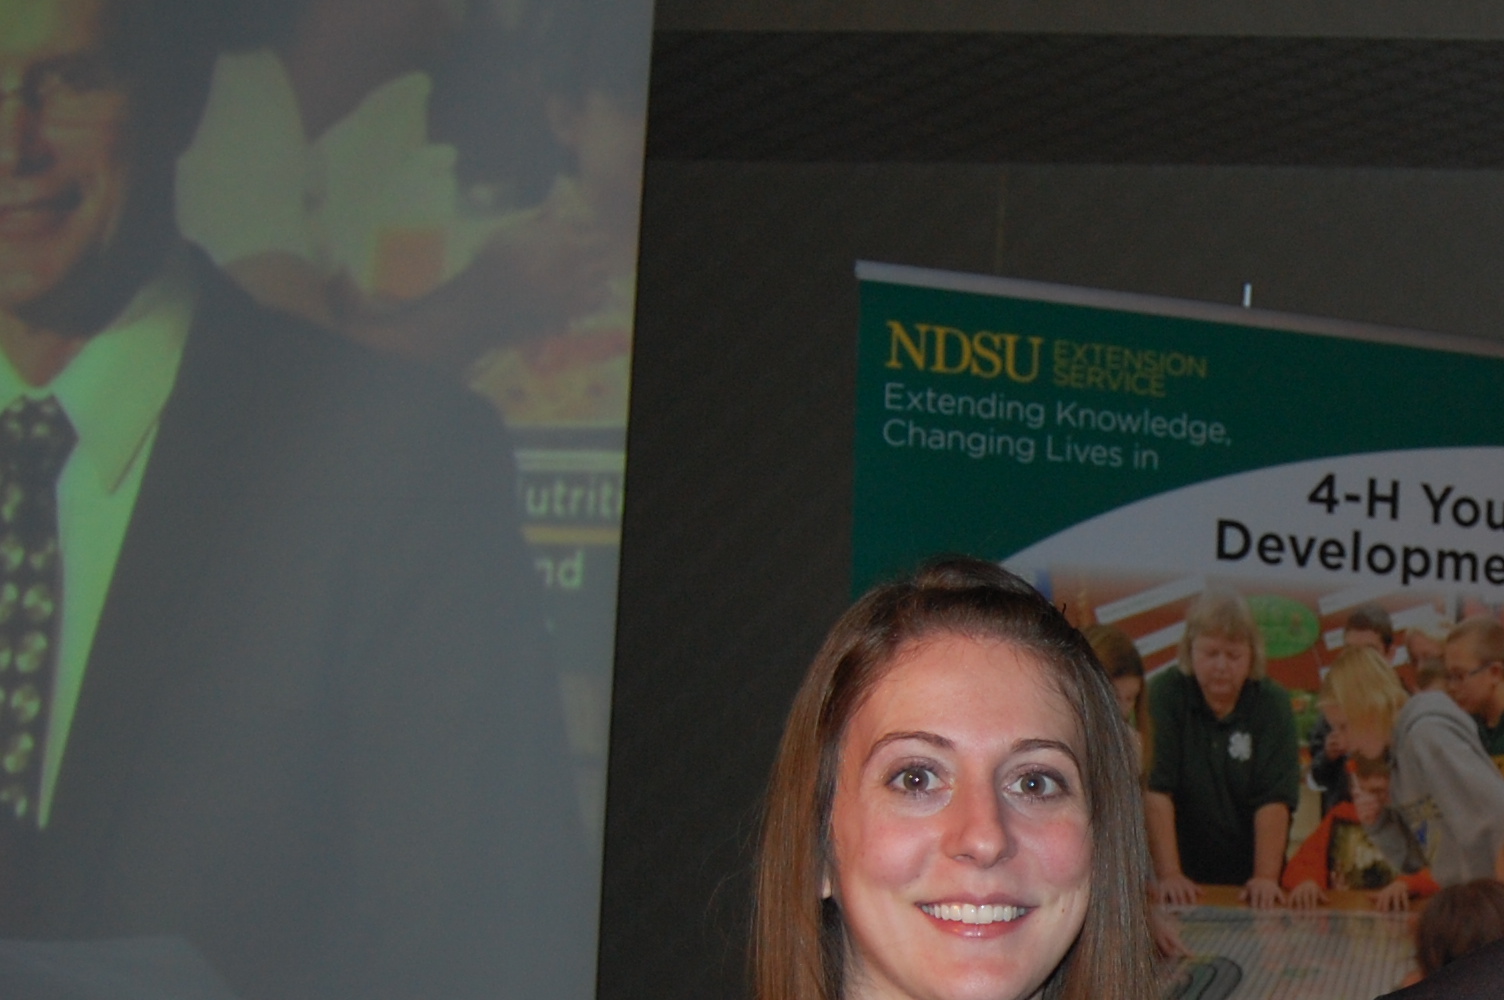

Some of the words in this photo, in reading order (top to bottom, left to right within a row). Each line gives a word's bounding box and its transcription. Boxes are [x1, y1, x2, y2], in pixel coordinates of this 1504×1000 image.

[885, 320, 1044, 383] NDSU
[1054, 340, 1209, 378] EXTENSION
[1053, 363, 1166, 397] SERVICE
[884, 382, 1045, 429] Extending
[1056, 401, 1232, 446] Knowledge,
[883, 418, 1036, 464] Changing
[1047, 434, 1122, 467] Lives
[1134, 445, 1159, 470] in
[524, 478, 622, 518] utrit
[1307, 473, 1399, 520] 4-H
